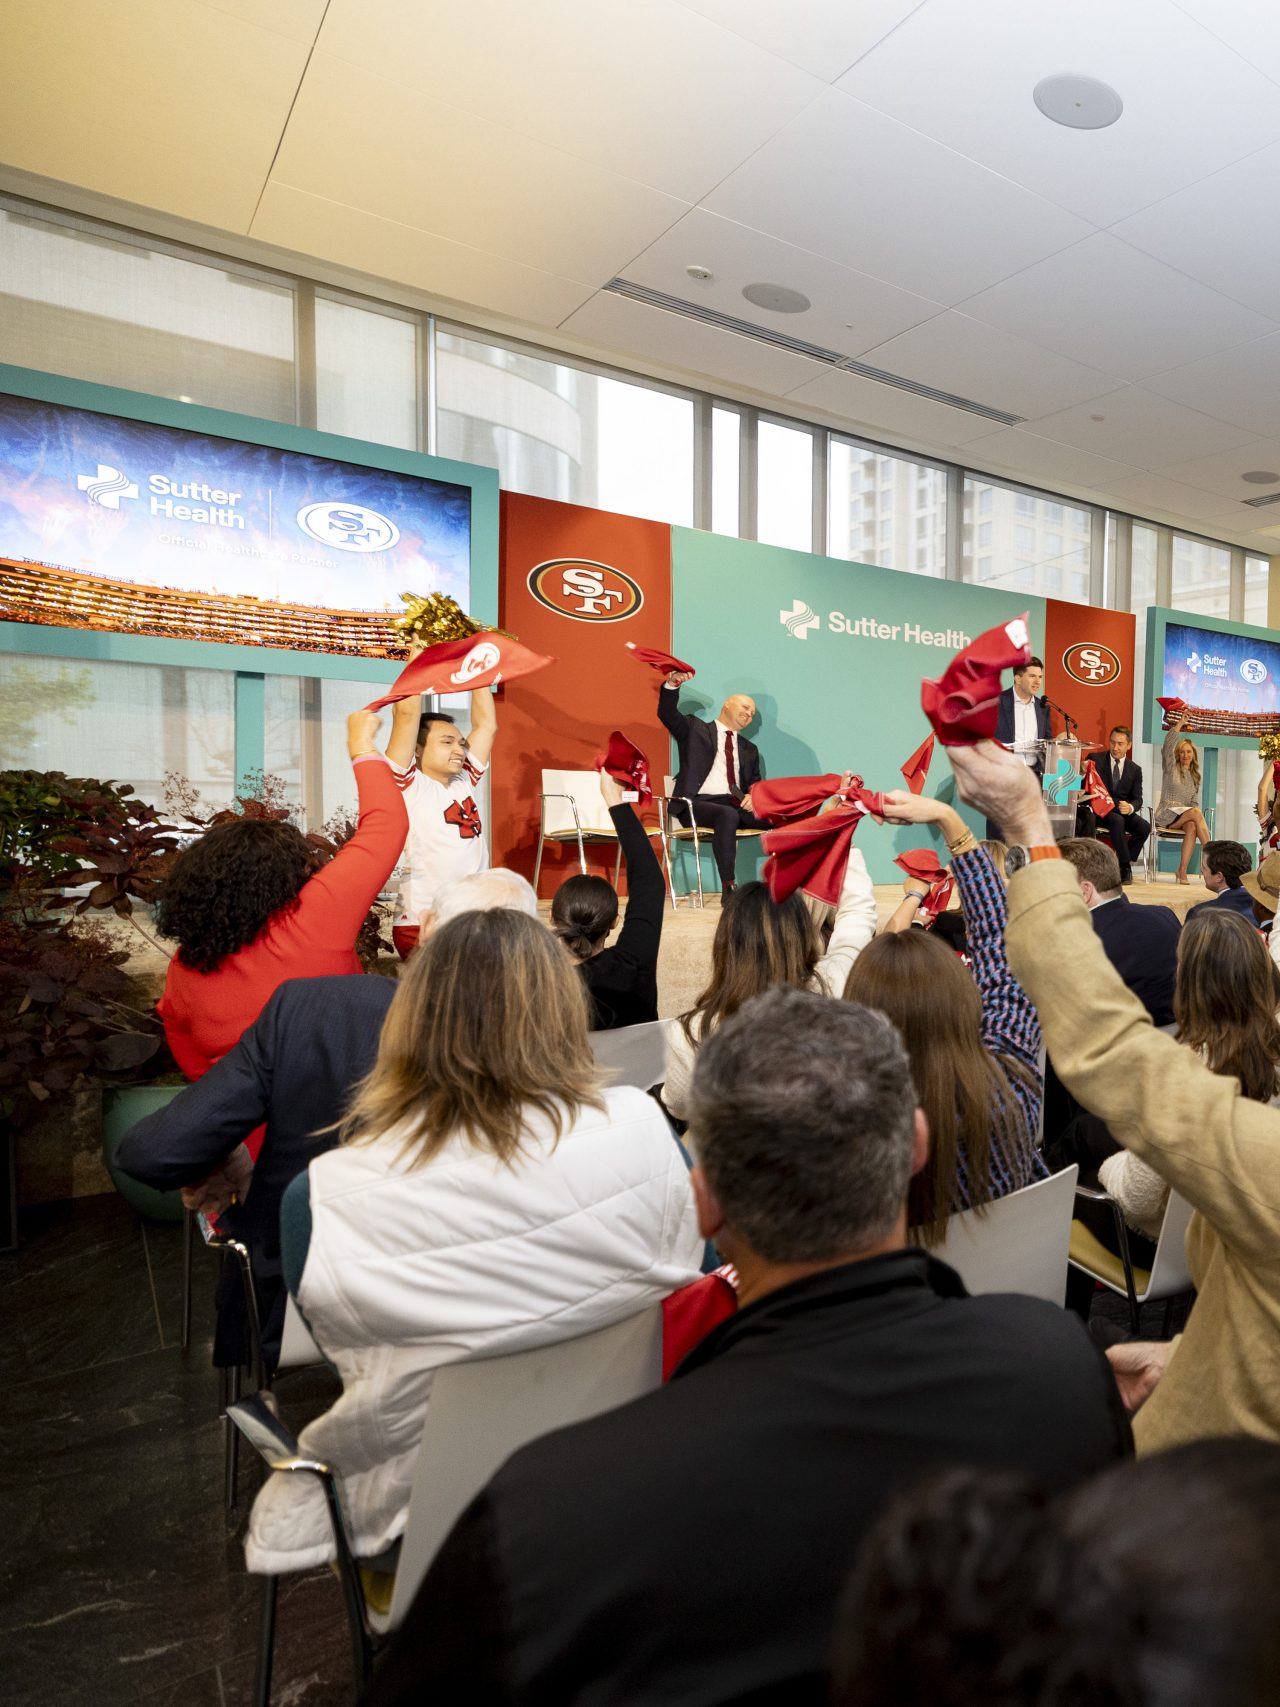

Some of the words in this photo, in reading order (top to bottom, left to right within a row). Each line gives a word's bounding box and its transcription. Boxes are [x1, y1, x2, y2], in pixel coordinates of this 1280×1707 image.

[148, 474, 241, 506] Sutter
[150, 496, 245, 529] Health
[158, 533, 210, 550] Official
[291, 553, 340, 569] Partner
[562, 568, 623, 615] SF
[828, 611, 901, 641] Sutter
[904, 622, 971, 650] Health
[1080, 649, 1111, 680] SF
[1203, 653, 1227, 667] Sutter
[1203, 664, 1228, 677] Health
